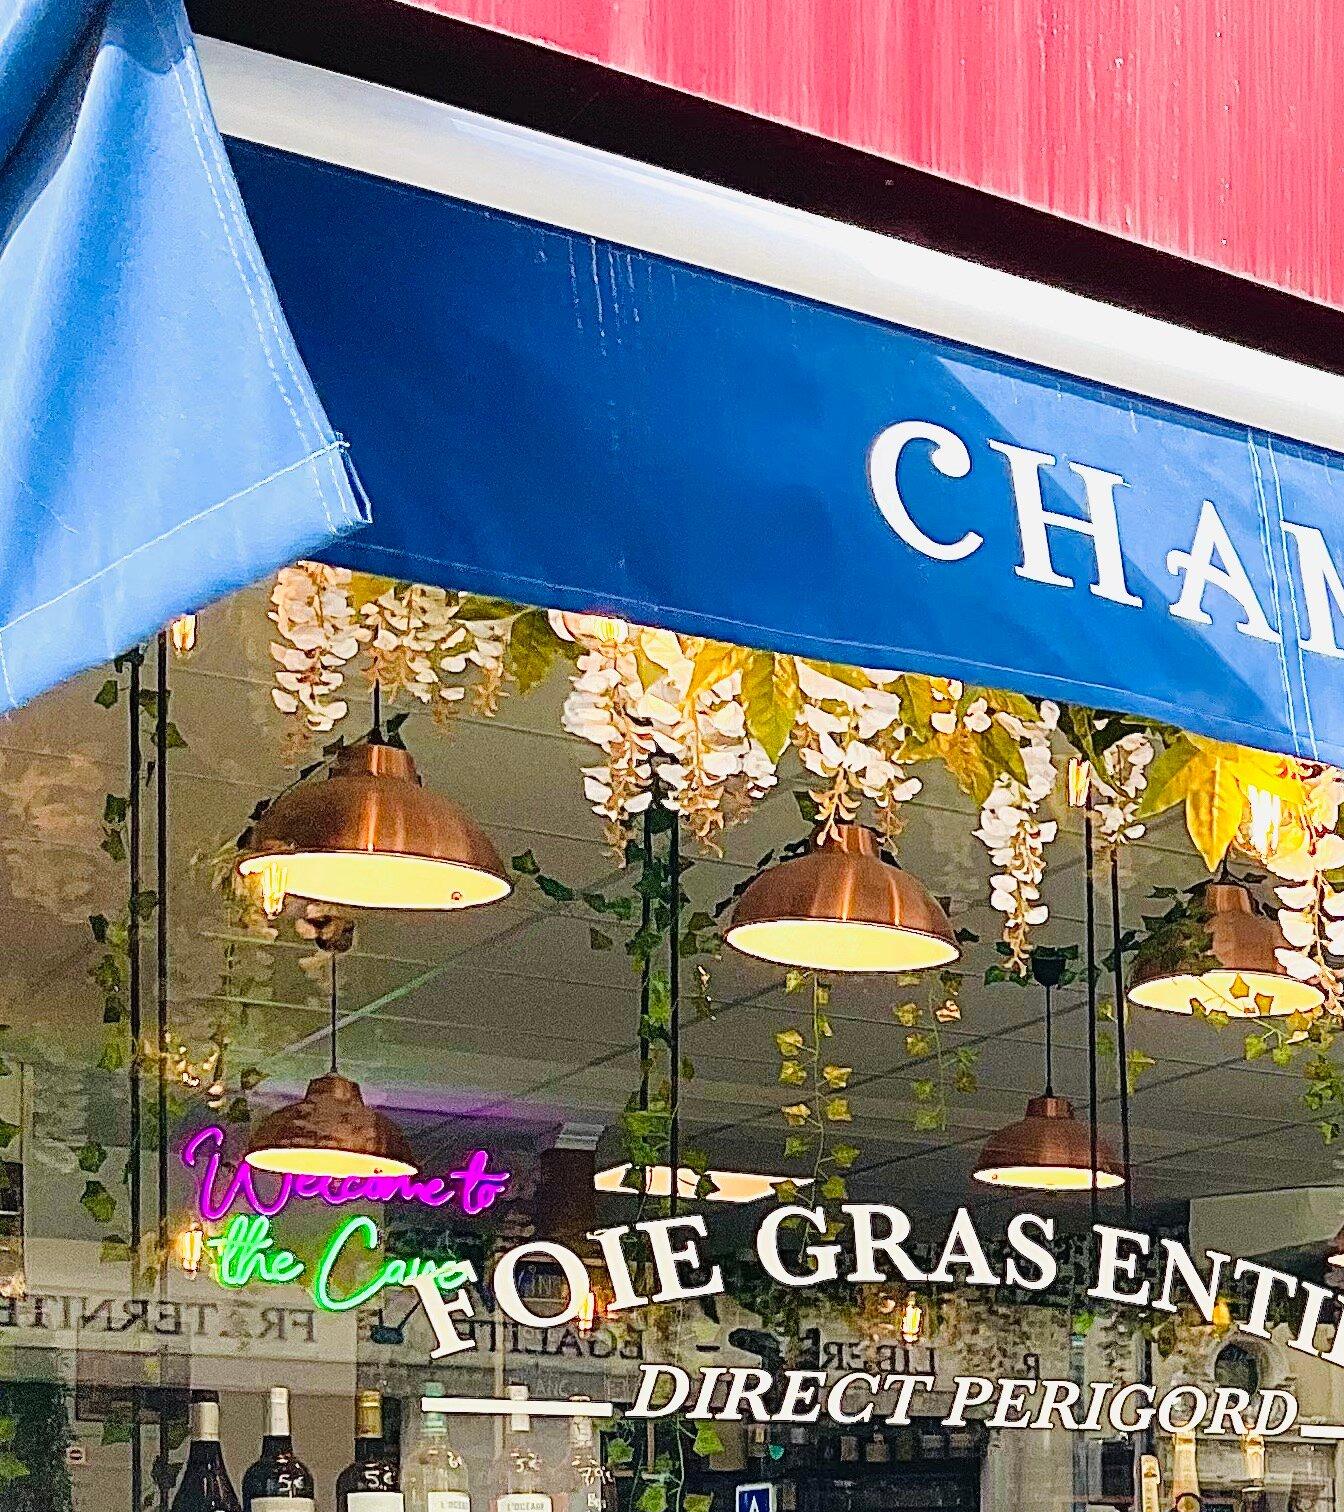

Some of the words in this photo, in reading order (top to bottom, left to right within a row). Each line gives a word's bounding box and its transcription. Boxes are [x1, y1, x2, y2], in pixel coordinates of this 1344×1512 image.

[448, 1149, 510, 1215] to
[206, 1213, 305, 1287] the
[414, 1215, 722, 1361] FOIE
[758, 1203, 1059, 1291] GRAS
[625, 1363, 935, 1427] DIRECT
[942, 1373, 1300, 1437] PERIGORD
